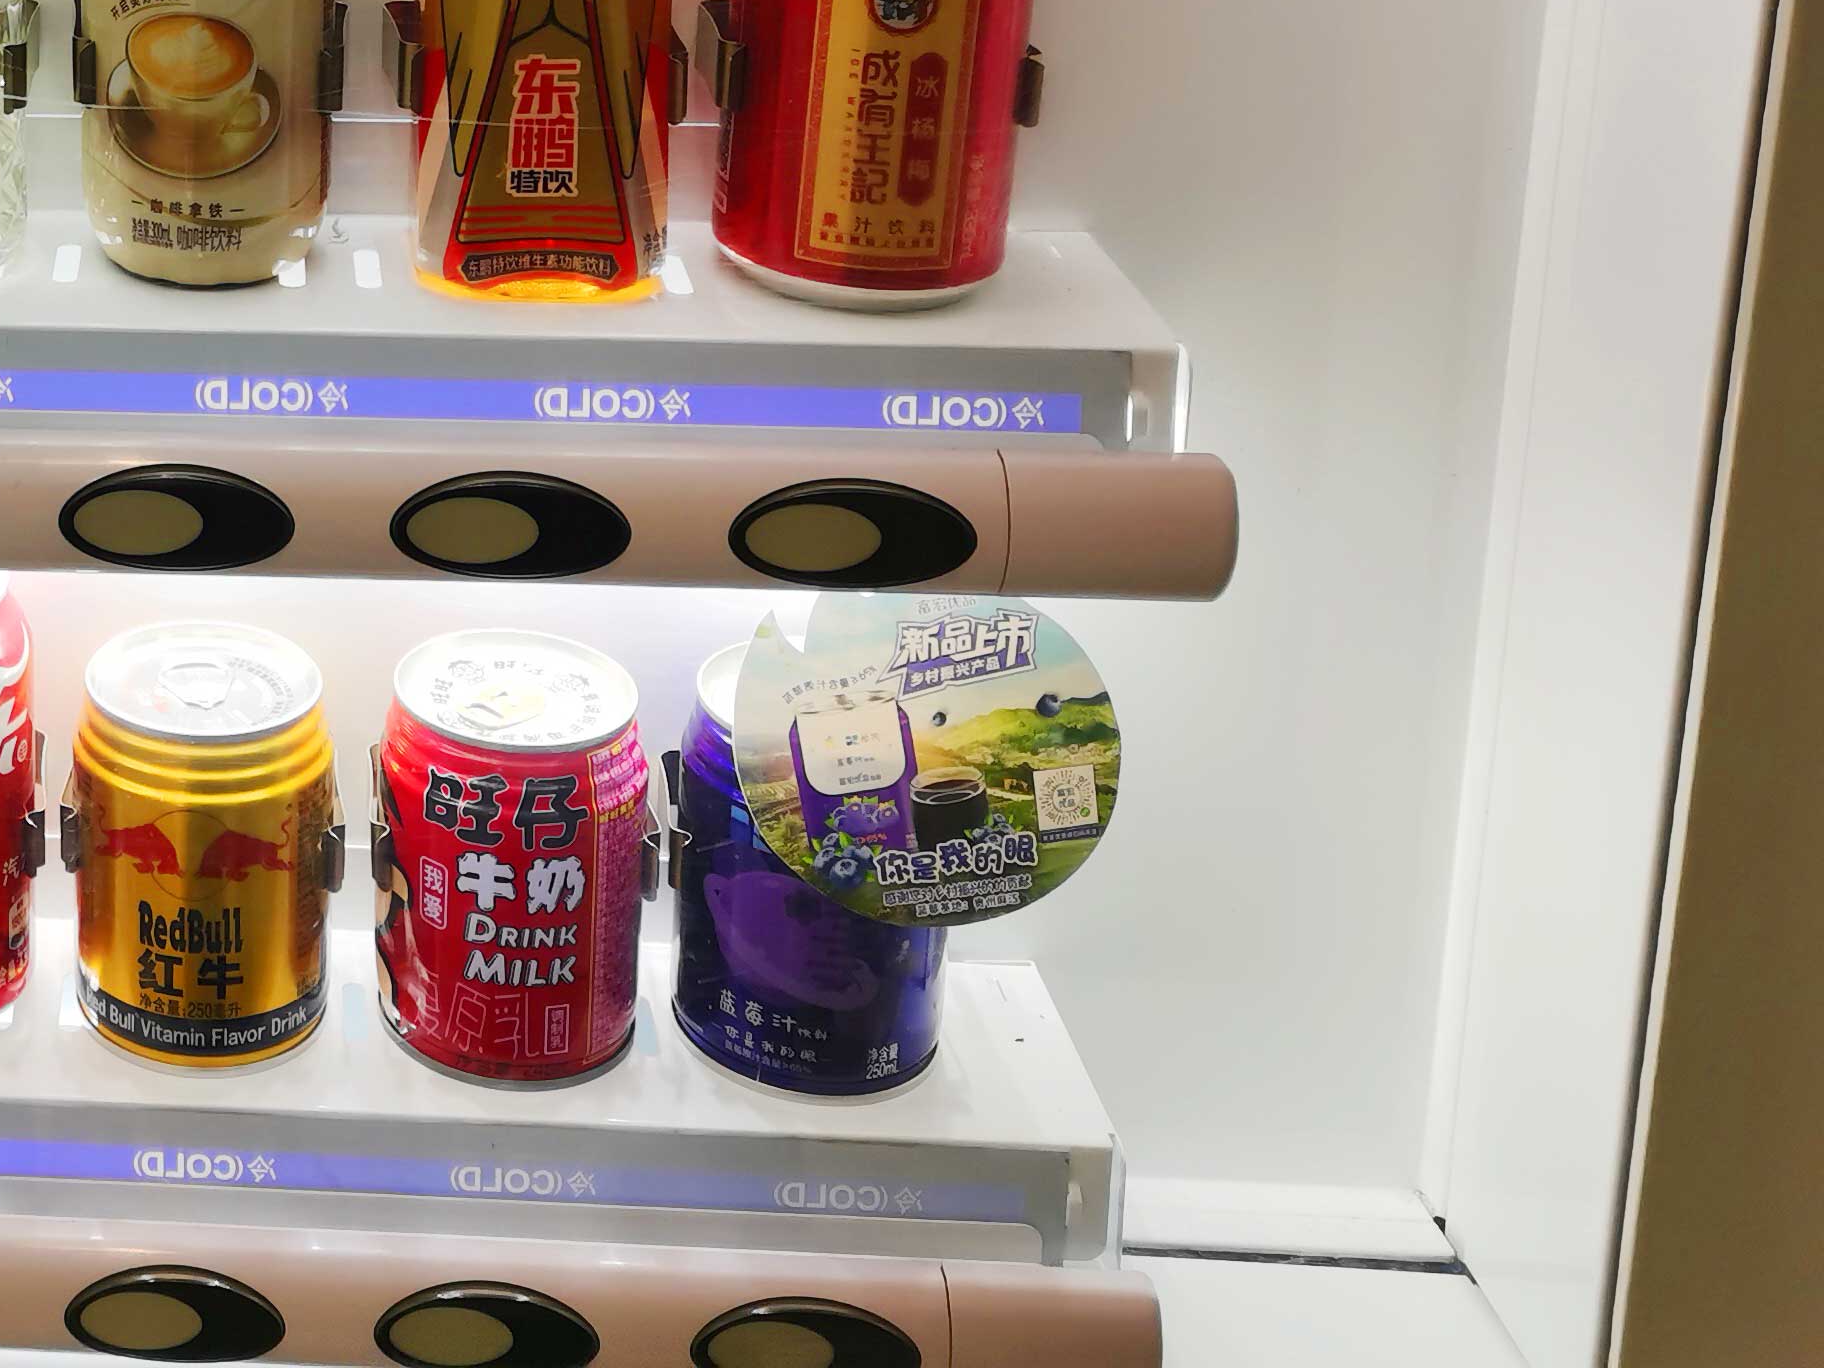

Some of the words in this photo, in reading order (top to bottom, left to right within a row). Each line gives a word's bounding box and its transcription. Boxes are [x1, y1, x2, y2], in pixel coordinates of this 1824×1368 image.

[510, 56, 579, 169] 东鹏
[509, 169, 575, 194] 特饮
[893, 615, 1033, 668] 新品上市
[424, 767, 590, 851] 旺仔
[457, 851, 586, 915] 牛奶
[876, 831, 1038, 886] 你是我的眼
[137, 899, 244, 955] RedBull
[137, 947, 244, 1001] 红牛
[109, 1003, 136, 1034] Bull
[139, 1015, 207, 1048] Vitamin
[211, 1024, 267, 1048] Flavor
[271, 1005, 308, 1038] Drink
